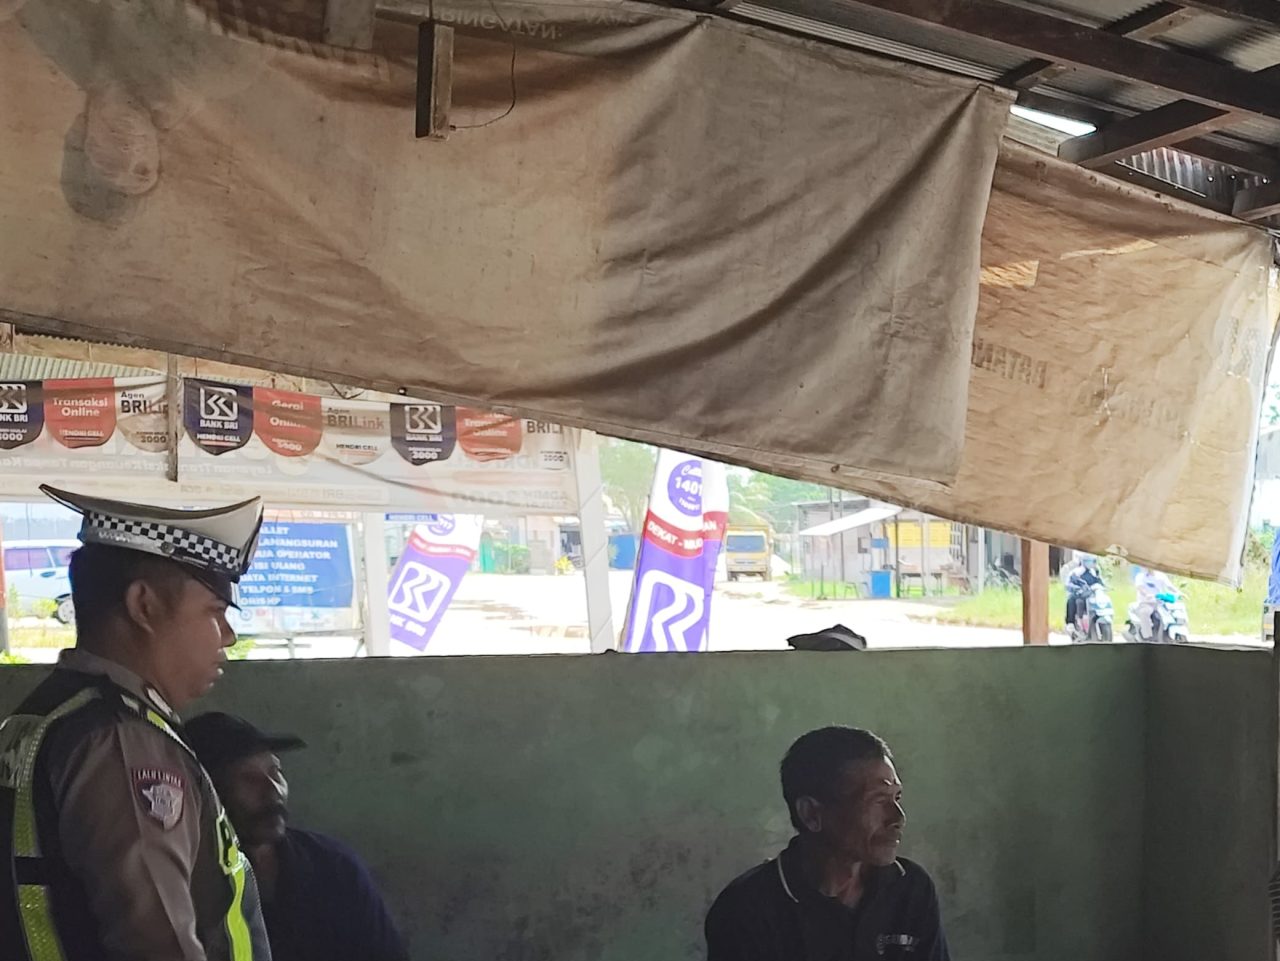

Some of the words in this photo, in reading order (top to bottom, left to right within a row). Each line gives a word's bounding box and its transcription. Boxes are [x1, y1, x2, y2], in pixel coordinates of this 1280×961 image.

[53, 397, 108, 407] Transaksi
[61, 407, 100, 417] Online
[223, 421, 239, 430] BRI
